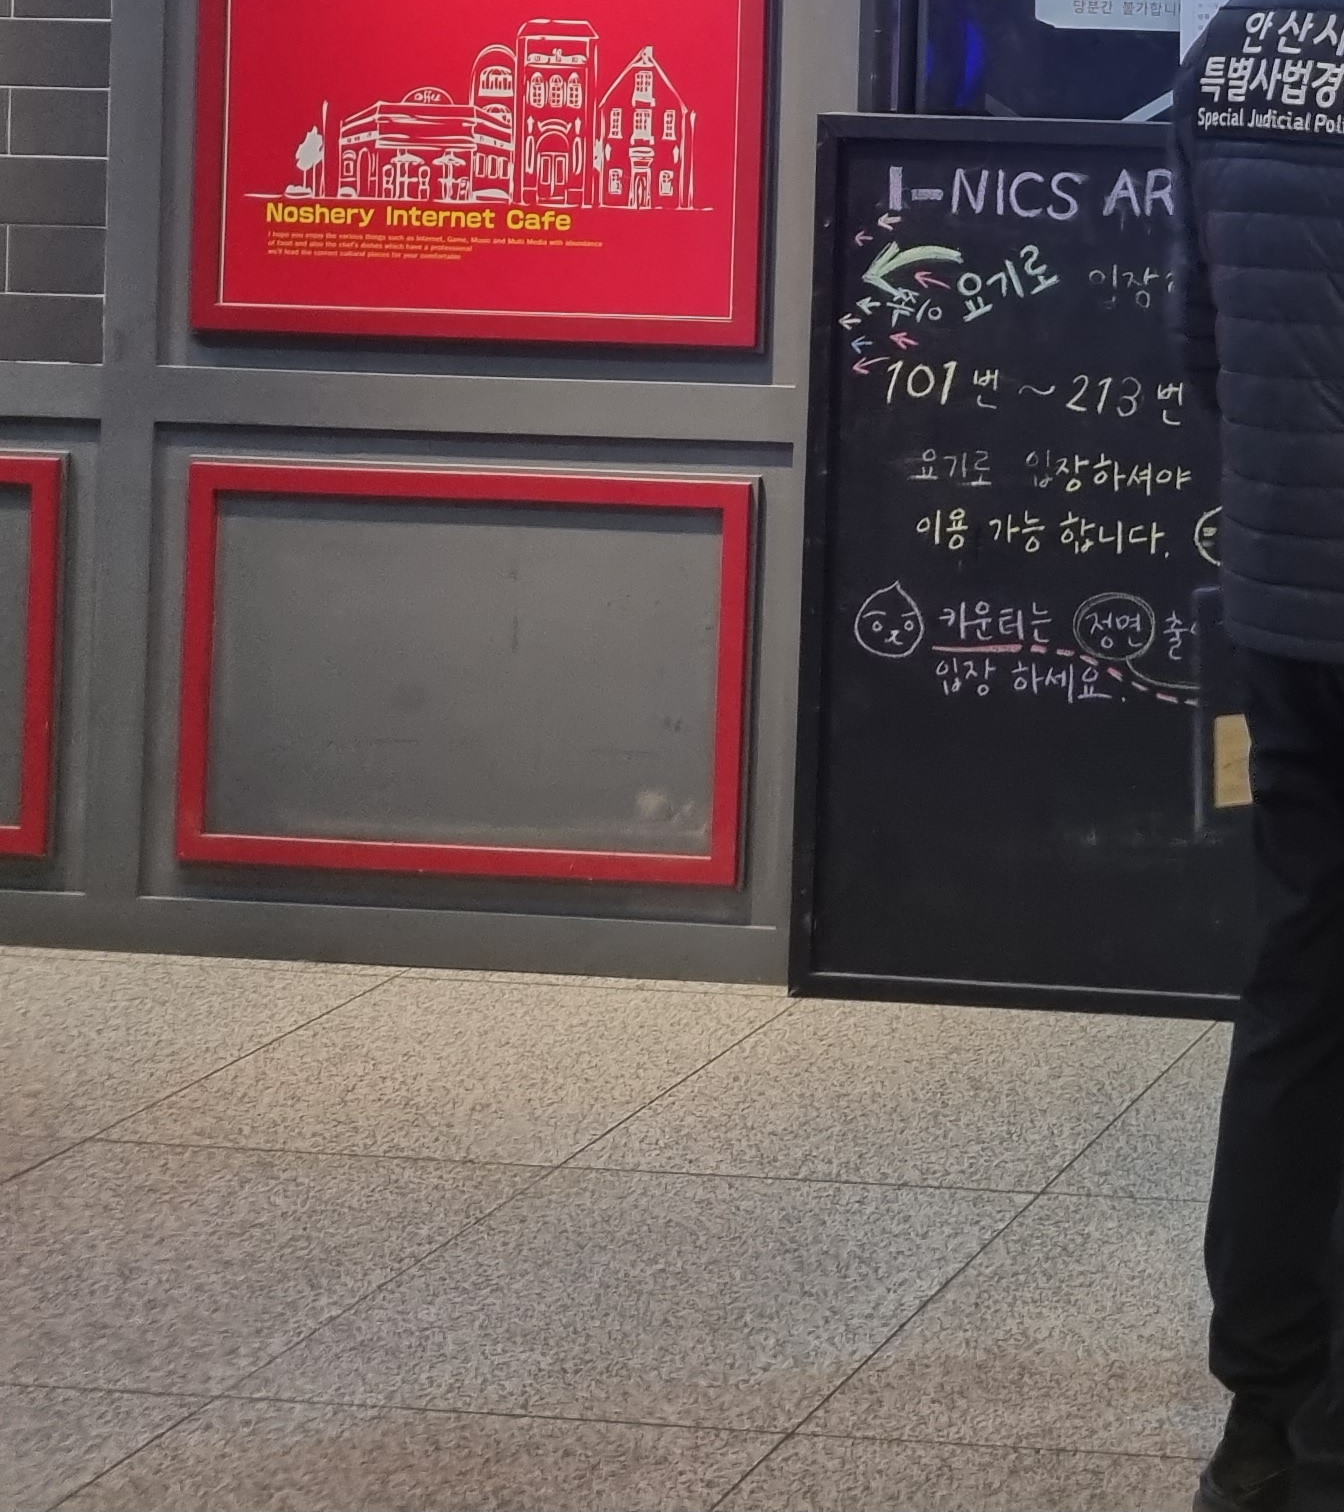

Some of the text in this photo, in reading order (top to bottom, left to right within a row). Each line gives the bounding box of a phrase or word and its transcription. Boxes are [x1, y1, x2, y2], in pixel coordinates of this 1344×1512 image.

[1072, 0, 1113, 15] 당분간
[1122, 0, 1181, 17] 불가합니
[1197, 107, 1244, 131] Special
[1247, 108, 1312, 132] Judicial
[888, 165, 1090, 221] I-NICS
[266, 202, 572, 231] Noshery Internet Cafe
[957, 244, 1060, 324] 요기로
[906, 448, 993, 487] 요기로
[916, 507, 969, 551] 이용
[988, 508, 1046, 554] 가능
[938, 600, 1144, 650] 카운터는 정면
[935, 657, 997, 697] 입장
